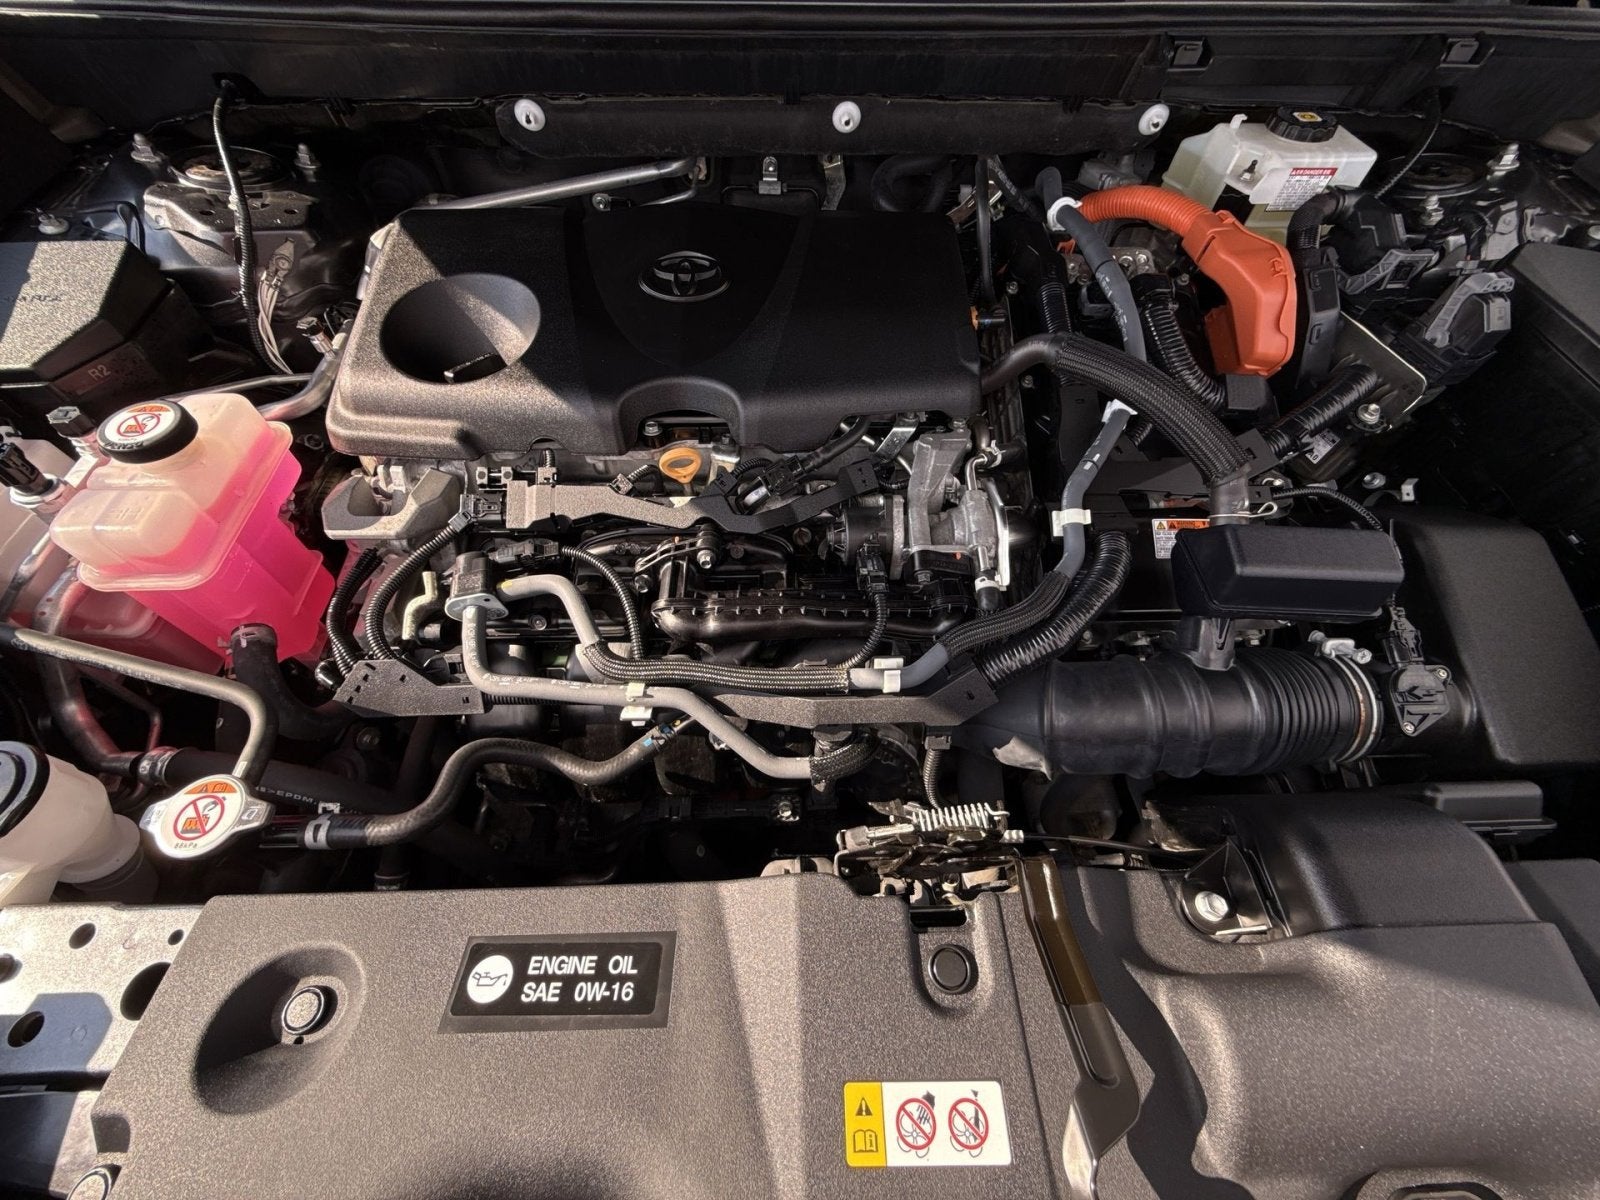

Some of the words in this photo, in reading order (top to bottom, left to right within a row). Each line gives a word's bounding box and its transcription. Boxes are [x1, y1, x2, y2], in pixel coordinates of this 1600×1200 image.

[87, 364, 111, 381] R2
[527, 955, 598, 975] ENGINE
[608, 955, 639, 975] OIL
[520, 981, 563, 1002] SAE
[574, 981, 635, 1002] 0W-16
